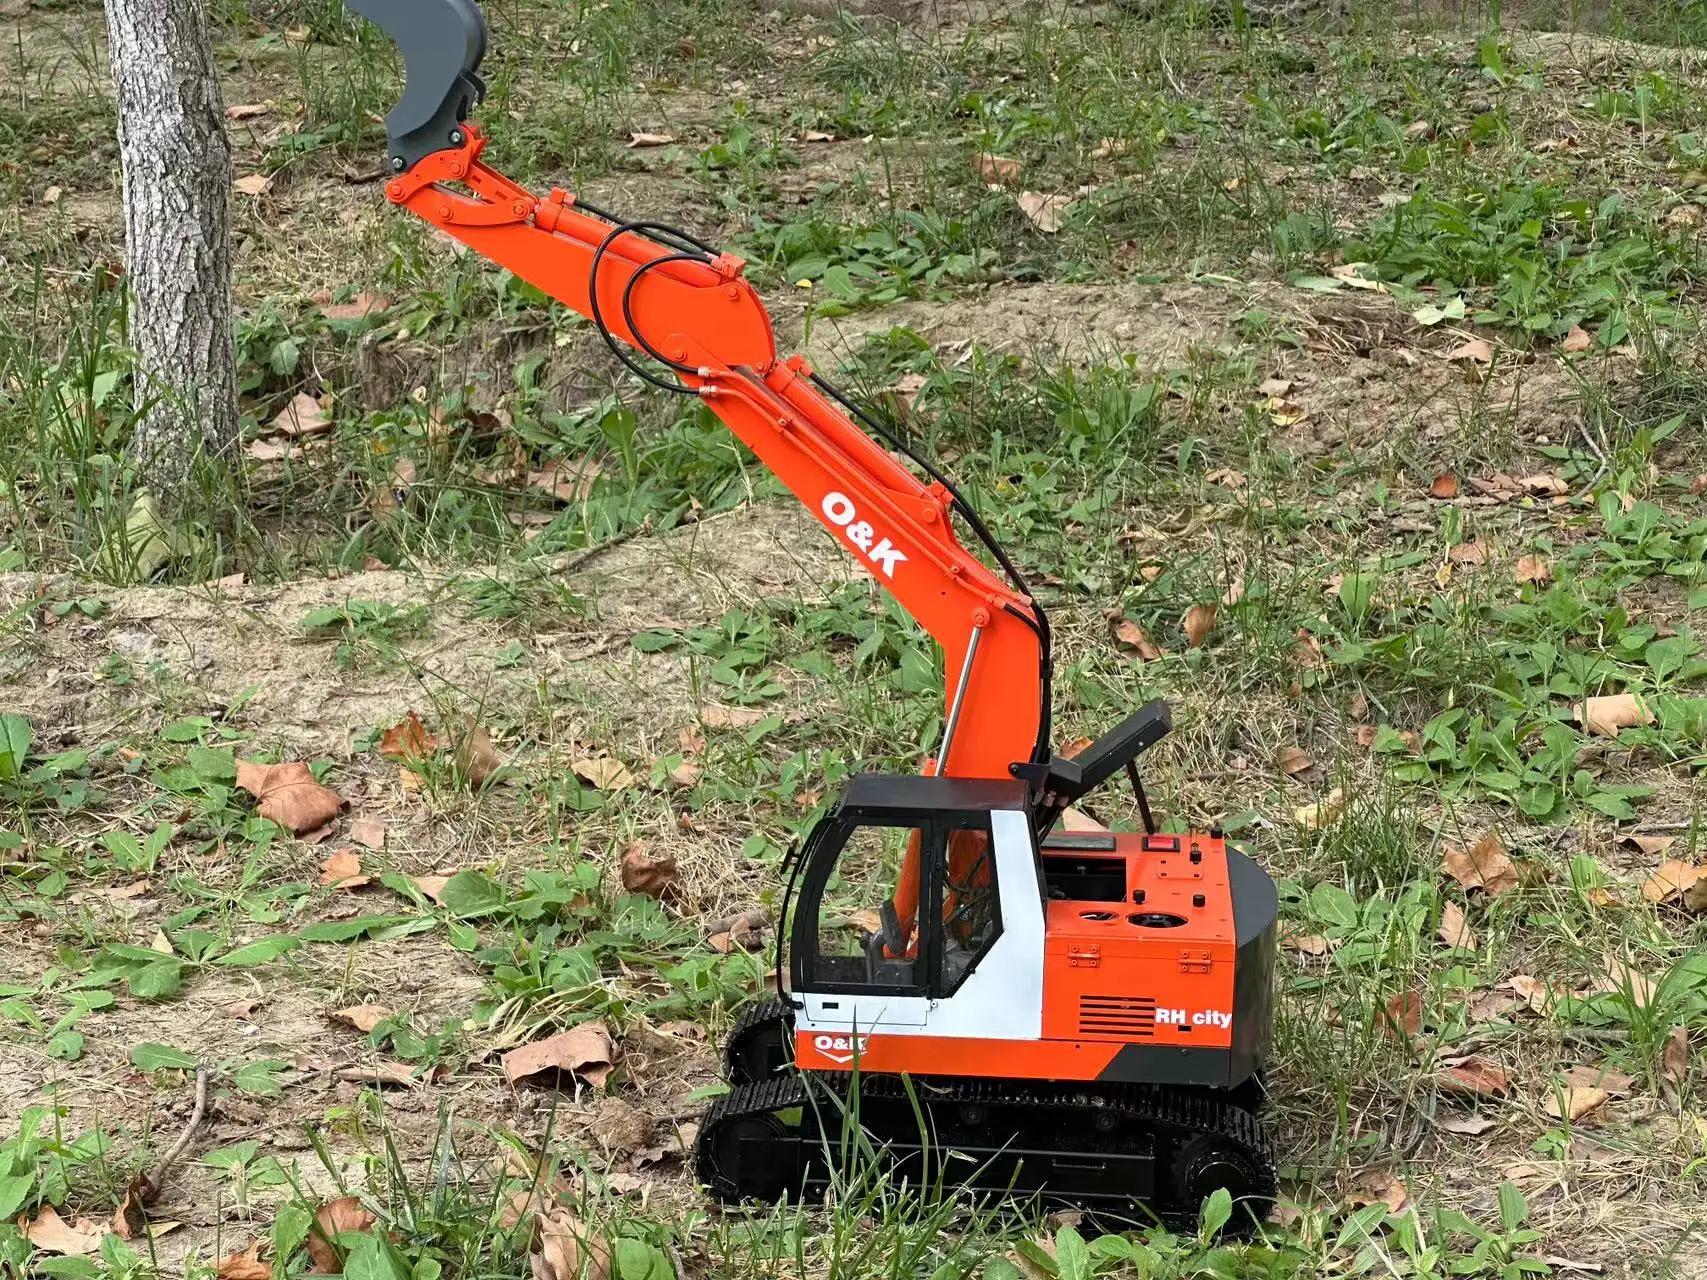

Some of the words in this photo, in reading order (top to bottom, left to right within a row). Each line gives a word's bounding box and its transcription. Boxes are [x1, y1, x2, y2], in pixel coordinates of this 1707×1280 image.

[822, 491, 909, 580] O&K
[1155, 1008, 1186, 1025] RH
[1192, 1009, 1232, 1029] city
